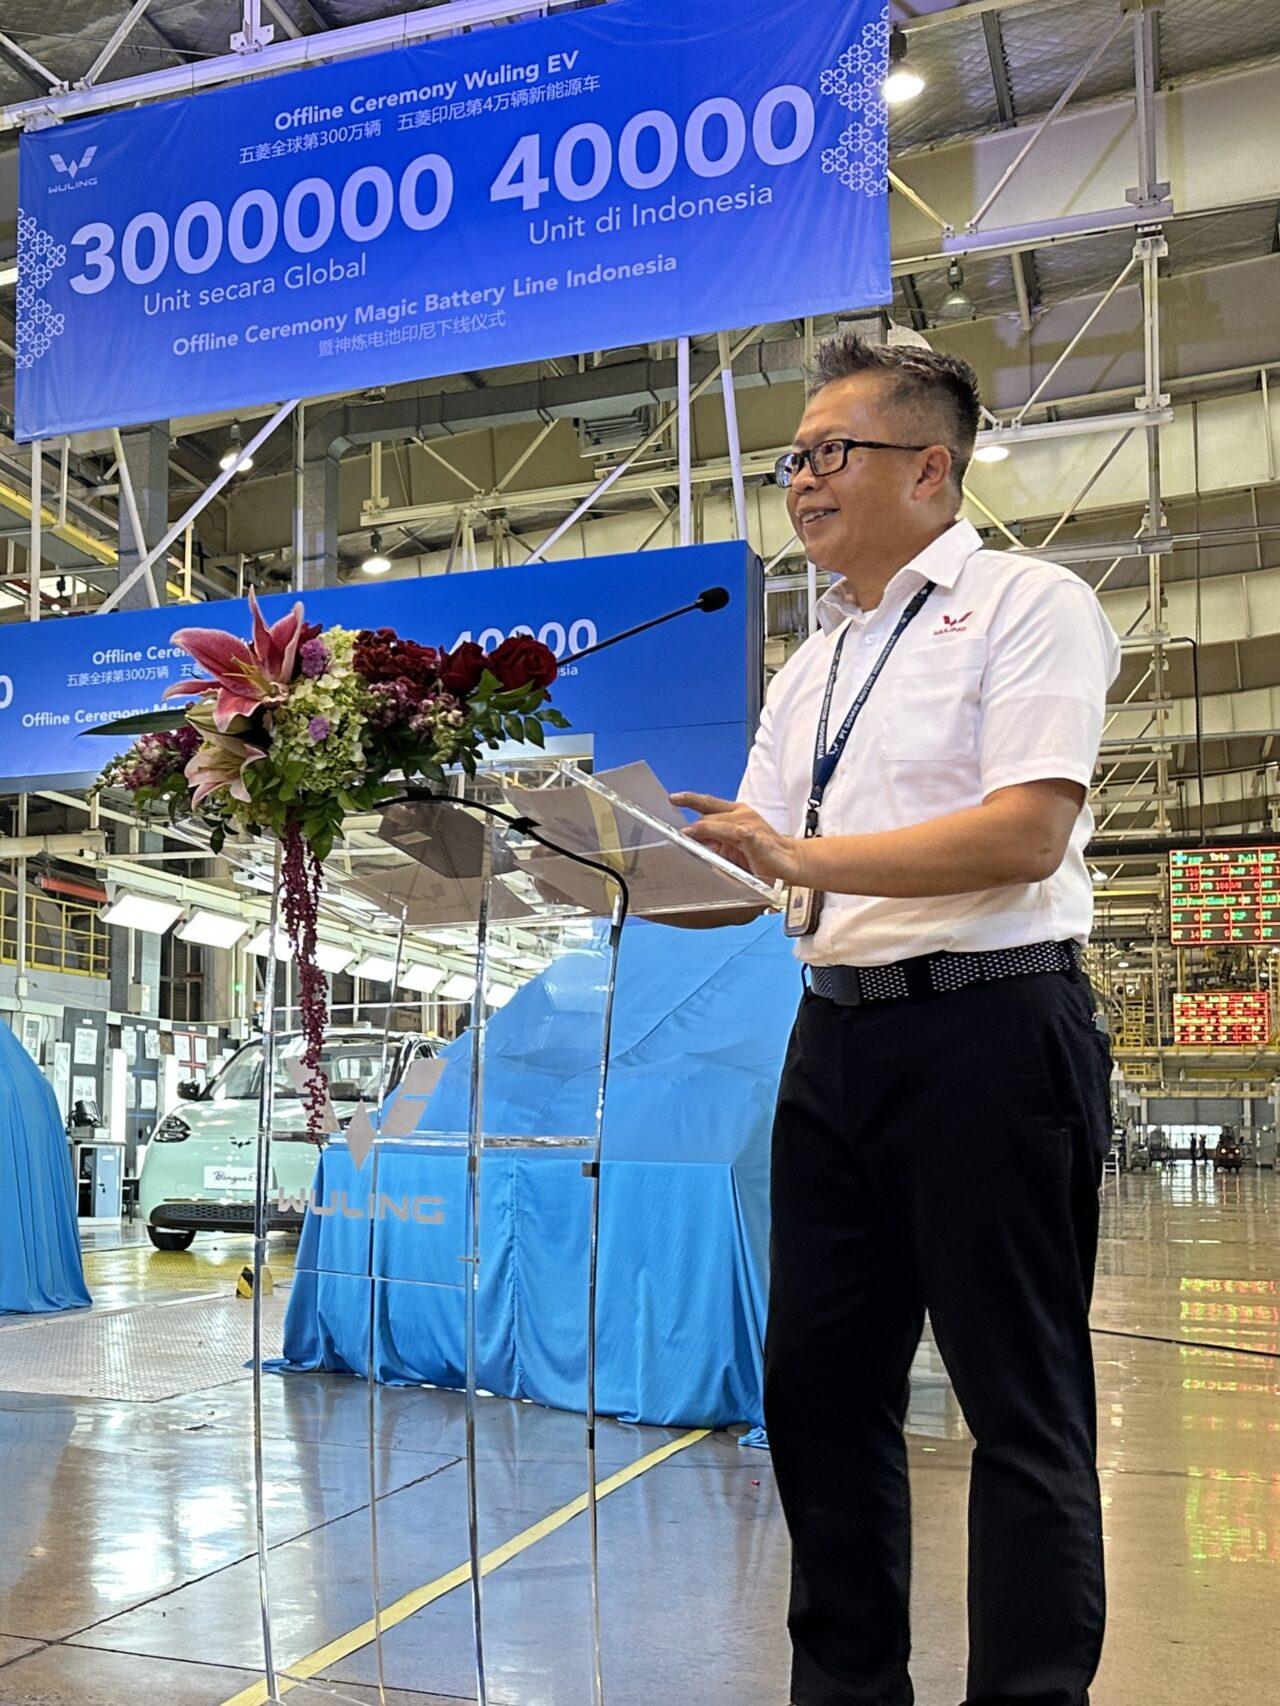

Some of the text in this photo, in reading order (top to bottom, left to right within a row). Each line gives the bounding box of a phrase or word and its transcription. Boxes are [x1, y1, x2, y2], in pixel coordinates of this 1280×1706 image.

[274, 50, 580, 131] Offline Ceremony Wuling EV
[238, 74, 601, 164] 五菱全球第300万辆 五菱印尼第4万辆新能源车
[48, 177, 98, 194] WULING
[69, 84, 816, 295] 3000000 40000
[529, 183, 773, 245] Unit di Indonesia
[143, 252, 367, 317] Unit secara Global
[173, 254, 677, 356] Offline Ceremony Magic Battery Line Indonesia
[318, 309, 507, 358] 暨神炼电池印尼下线仪式
[66, 665, 169, 687] 五菱全球第300万辆
[92, 645, 191, 665] Offline Cere
[22, 711, 70, 728] Offline
[277, 1186, 444, 1225] WULING
